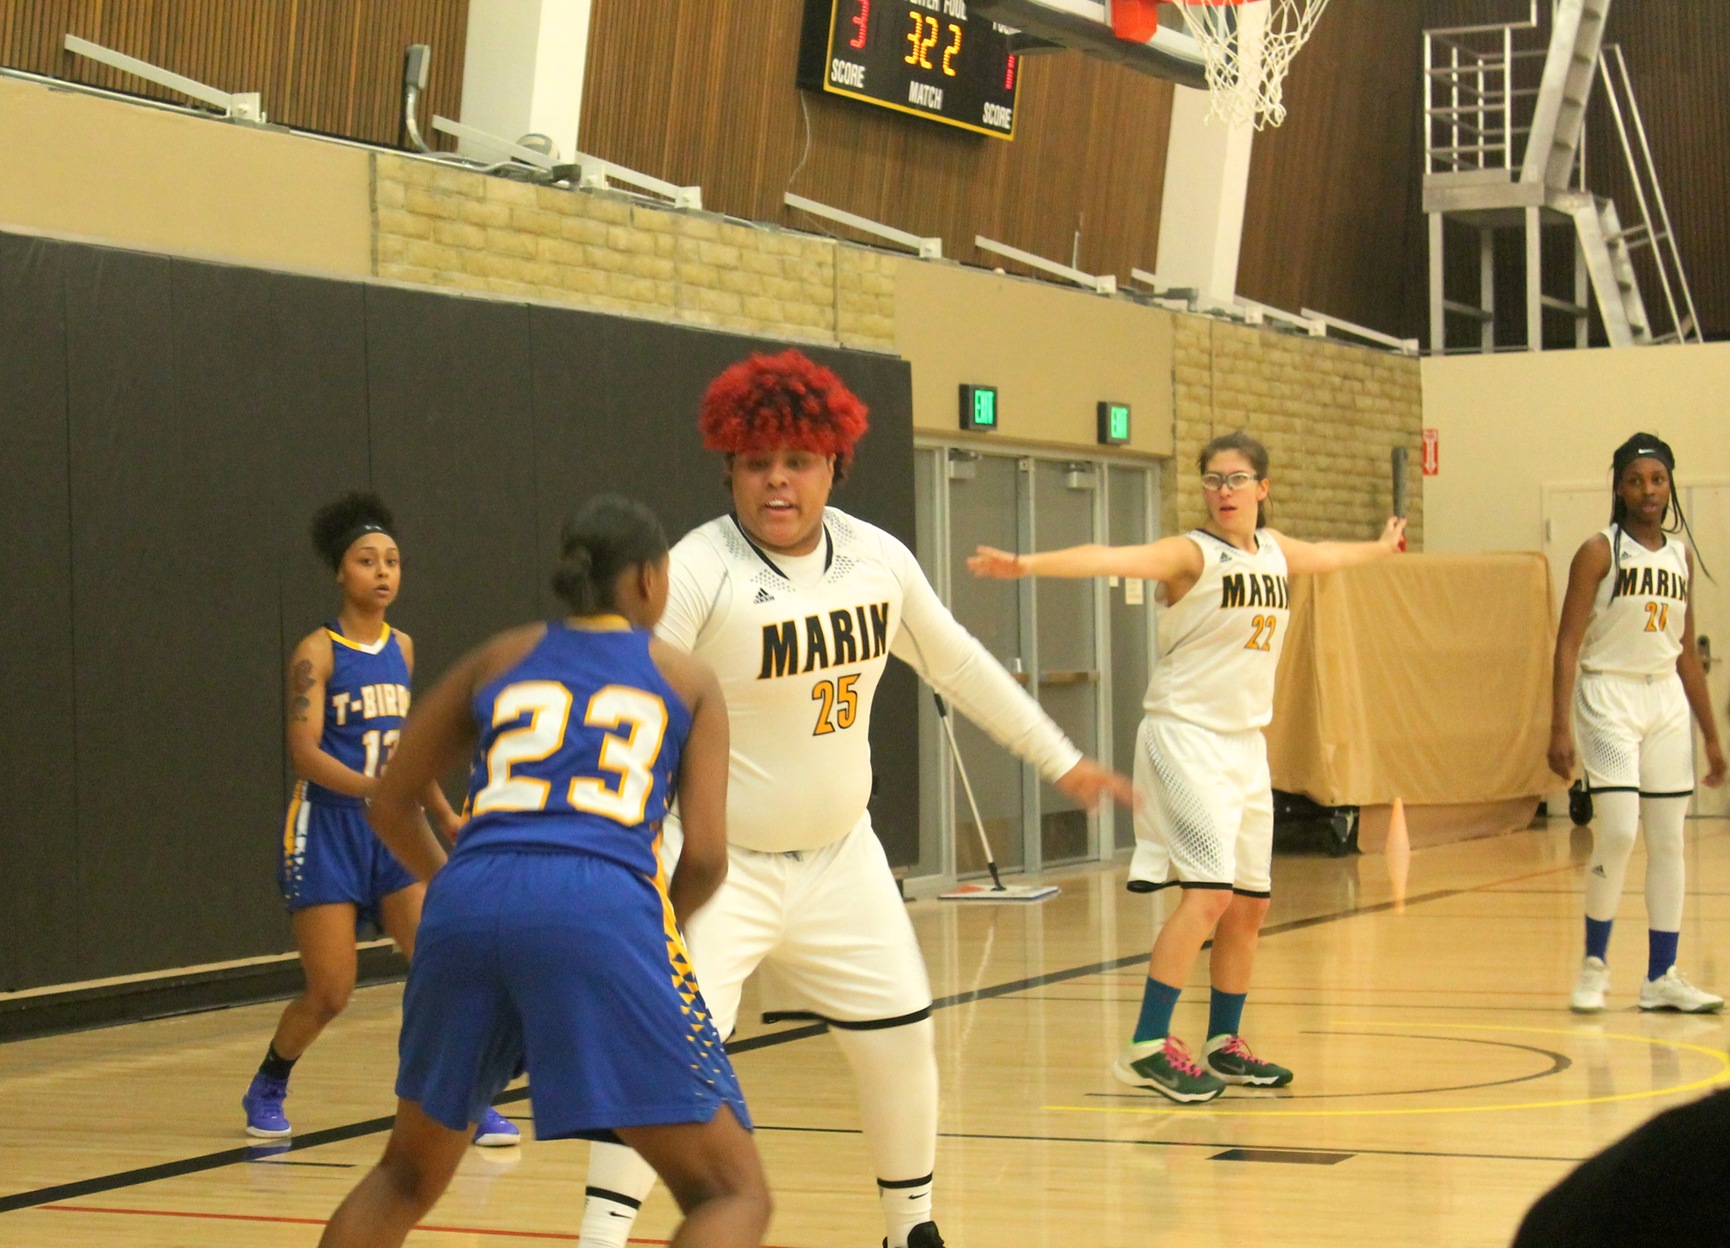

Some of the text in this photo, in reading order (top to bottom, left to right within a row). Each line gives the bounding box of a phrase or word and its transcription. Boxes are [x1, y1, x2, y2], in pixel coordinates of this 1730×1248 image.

[831, 58, 866, 89] SCORE
[909, 81, 943, 110] MATCH
[982, 102, 1012, 129] SCORE
[756, 602, 889, 680] MARIN
[1243, 614, 1277, 652] 22
[811, 673, 862, 736] 25
[472, 679, 669, 827] 23
